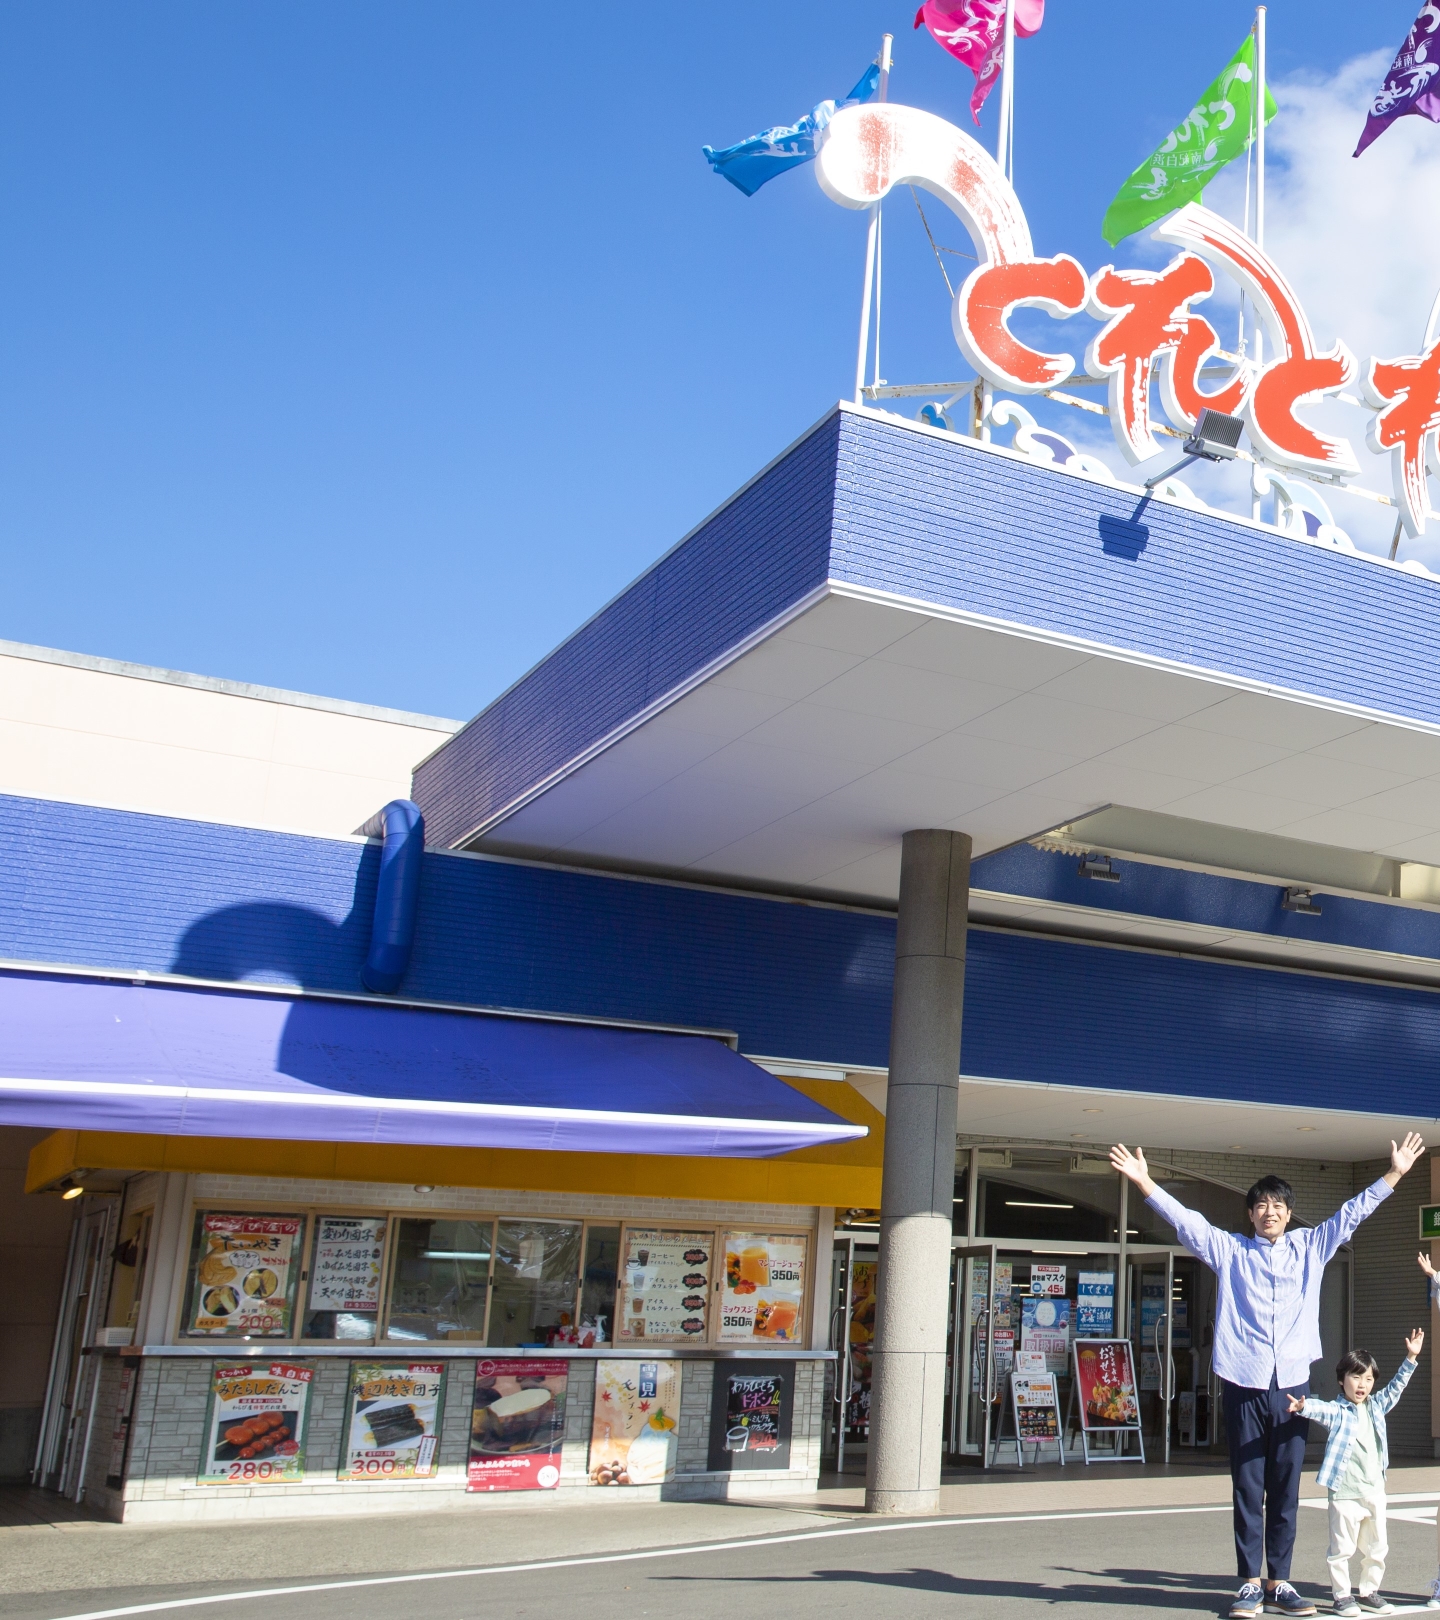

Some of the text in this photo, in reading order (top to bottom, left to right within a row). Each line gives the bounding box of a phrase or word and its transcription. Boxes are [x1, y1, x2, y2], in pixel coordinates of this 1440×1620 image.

[207, 1220, 296, 1232] わらび屋の
[321, 1227, 374, 1241] 変わり団子
[651, 1235, 711, 1244] ドリンクメニュー
[220, 1235, 281, 1251] たいやき
[759, 1260, 804, 1268] マンゴージュース
[772, 1270, 800, 1281] 350円
[1032, 1273, 1065, 1282] 個包装マスク
[1047, 1284, 1064, 1294] 45円
[722, 1306, 773, 1314] ミックスジュース
[238, 1315, 282, 1330] 200円
[723, 1317, 752, 1327] 350円
[1025, 1340, 1066, 1352] 取扱店
[1099, 1347, 1111, 1385] おせち
[271, 1366, 311, 1380] 味自慢
[641, 1364, 657, 1397] 雪見
[218, 1383, 302, 1395] みたらしだんご
[351, 1384, 442, 1397] 磯辺焼き団子
[622, 1379, 636, 1430] モンブラン
[227, 1462, 283, 1480] 280円
[351, 1459, 406, 1475] 300円
